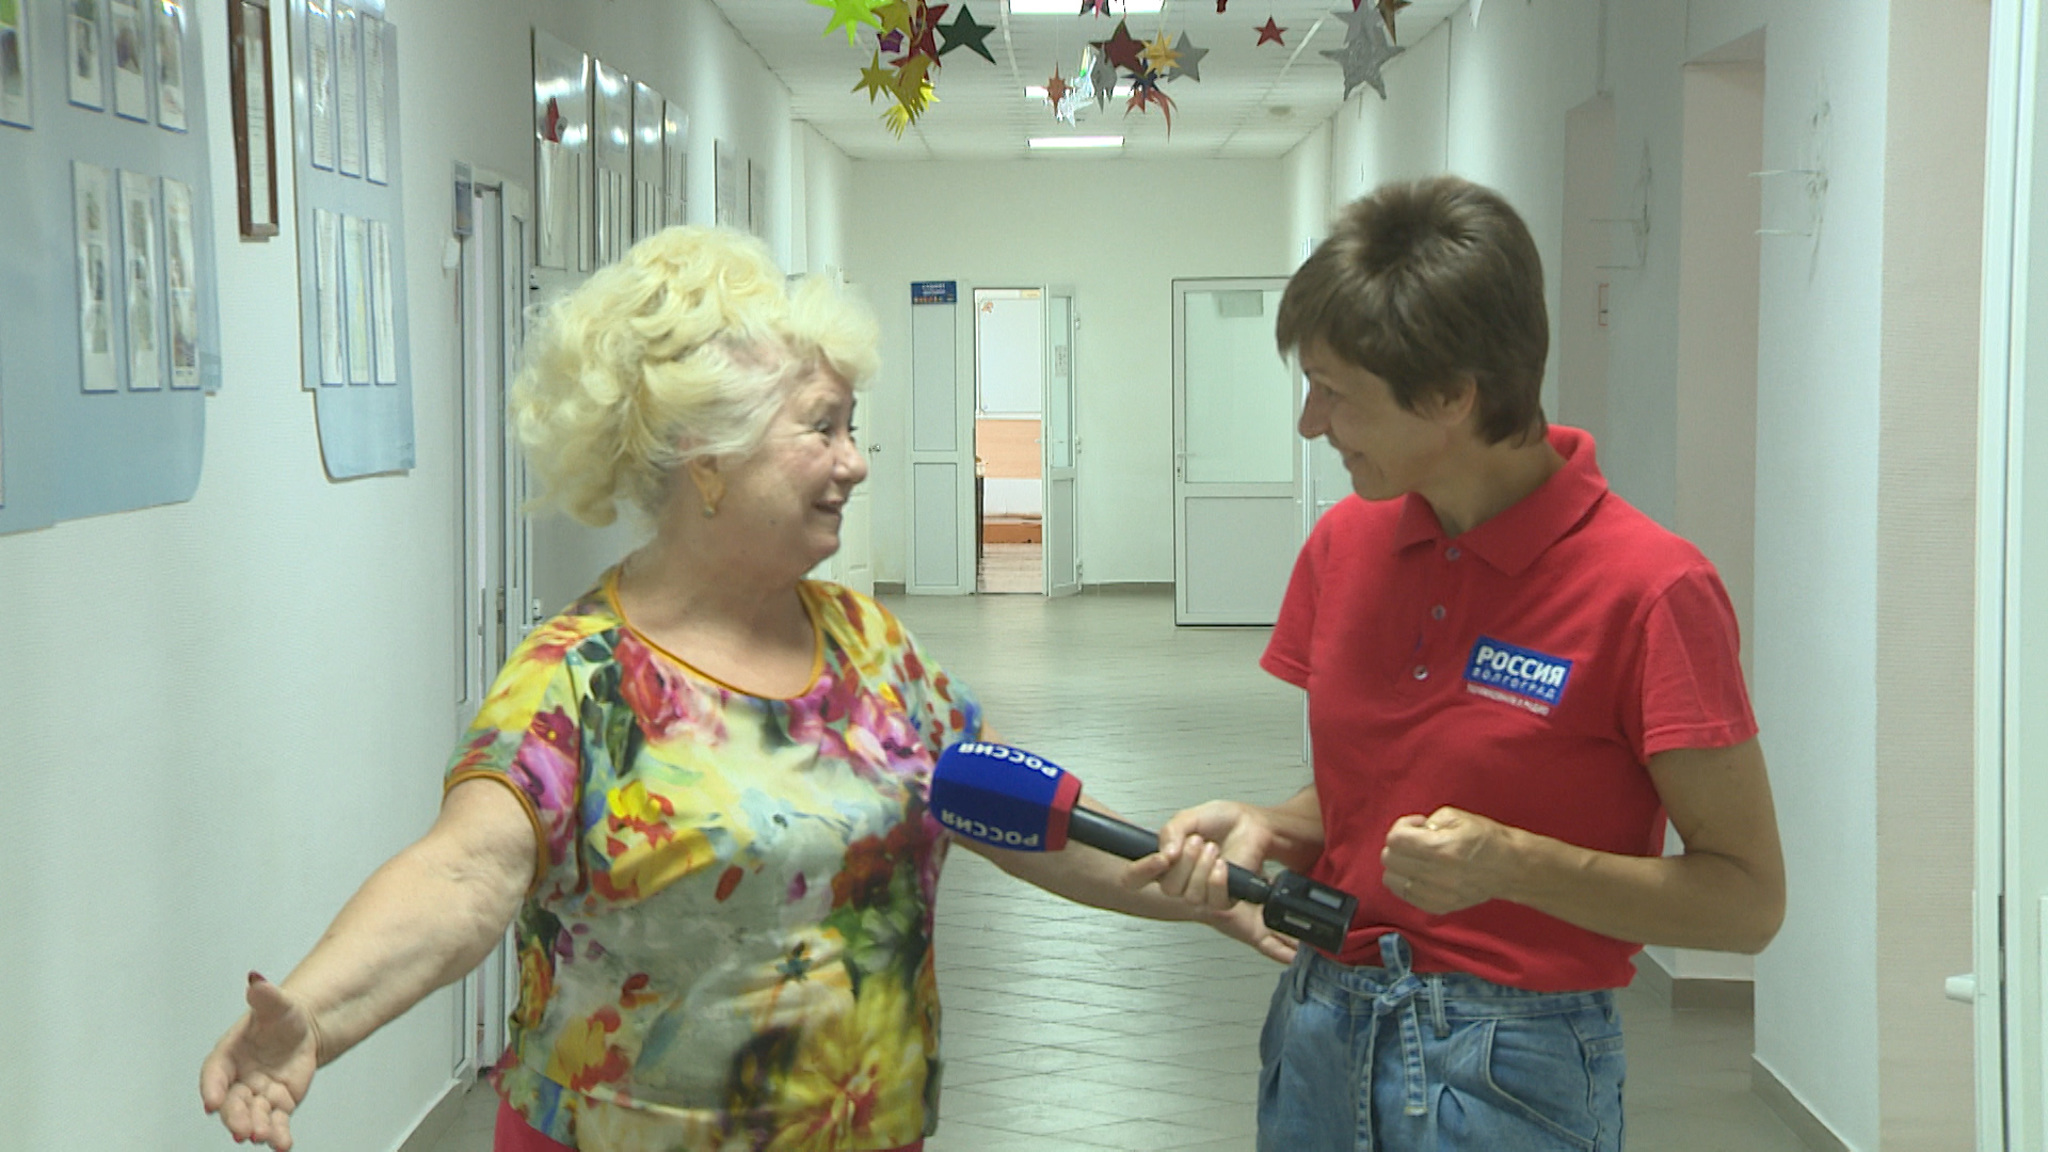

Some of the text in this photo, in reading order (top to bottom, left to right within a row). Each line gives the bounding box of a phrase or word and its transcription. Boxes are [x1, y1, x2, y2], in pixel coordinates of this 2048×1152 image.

[1472, 667, 1557, 699] ВОЛГОГРАД
[1476, 645, 1566, 687] РОССИЯ
[958, 743, 1058, 779] РОССИЯ
[941, 808, 1039, 847] РОССИЯ
